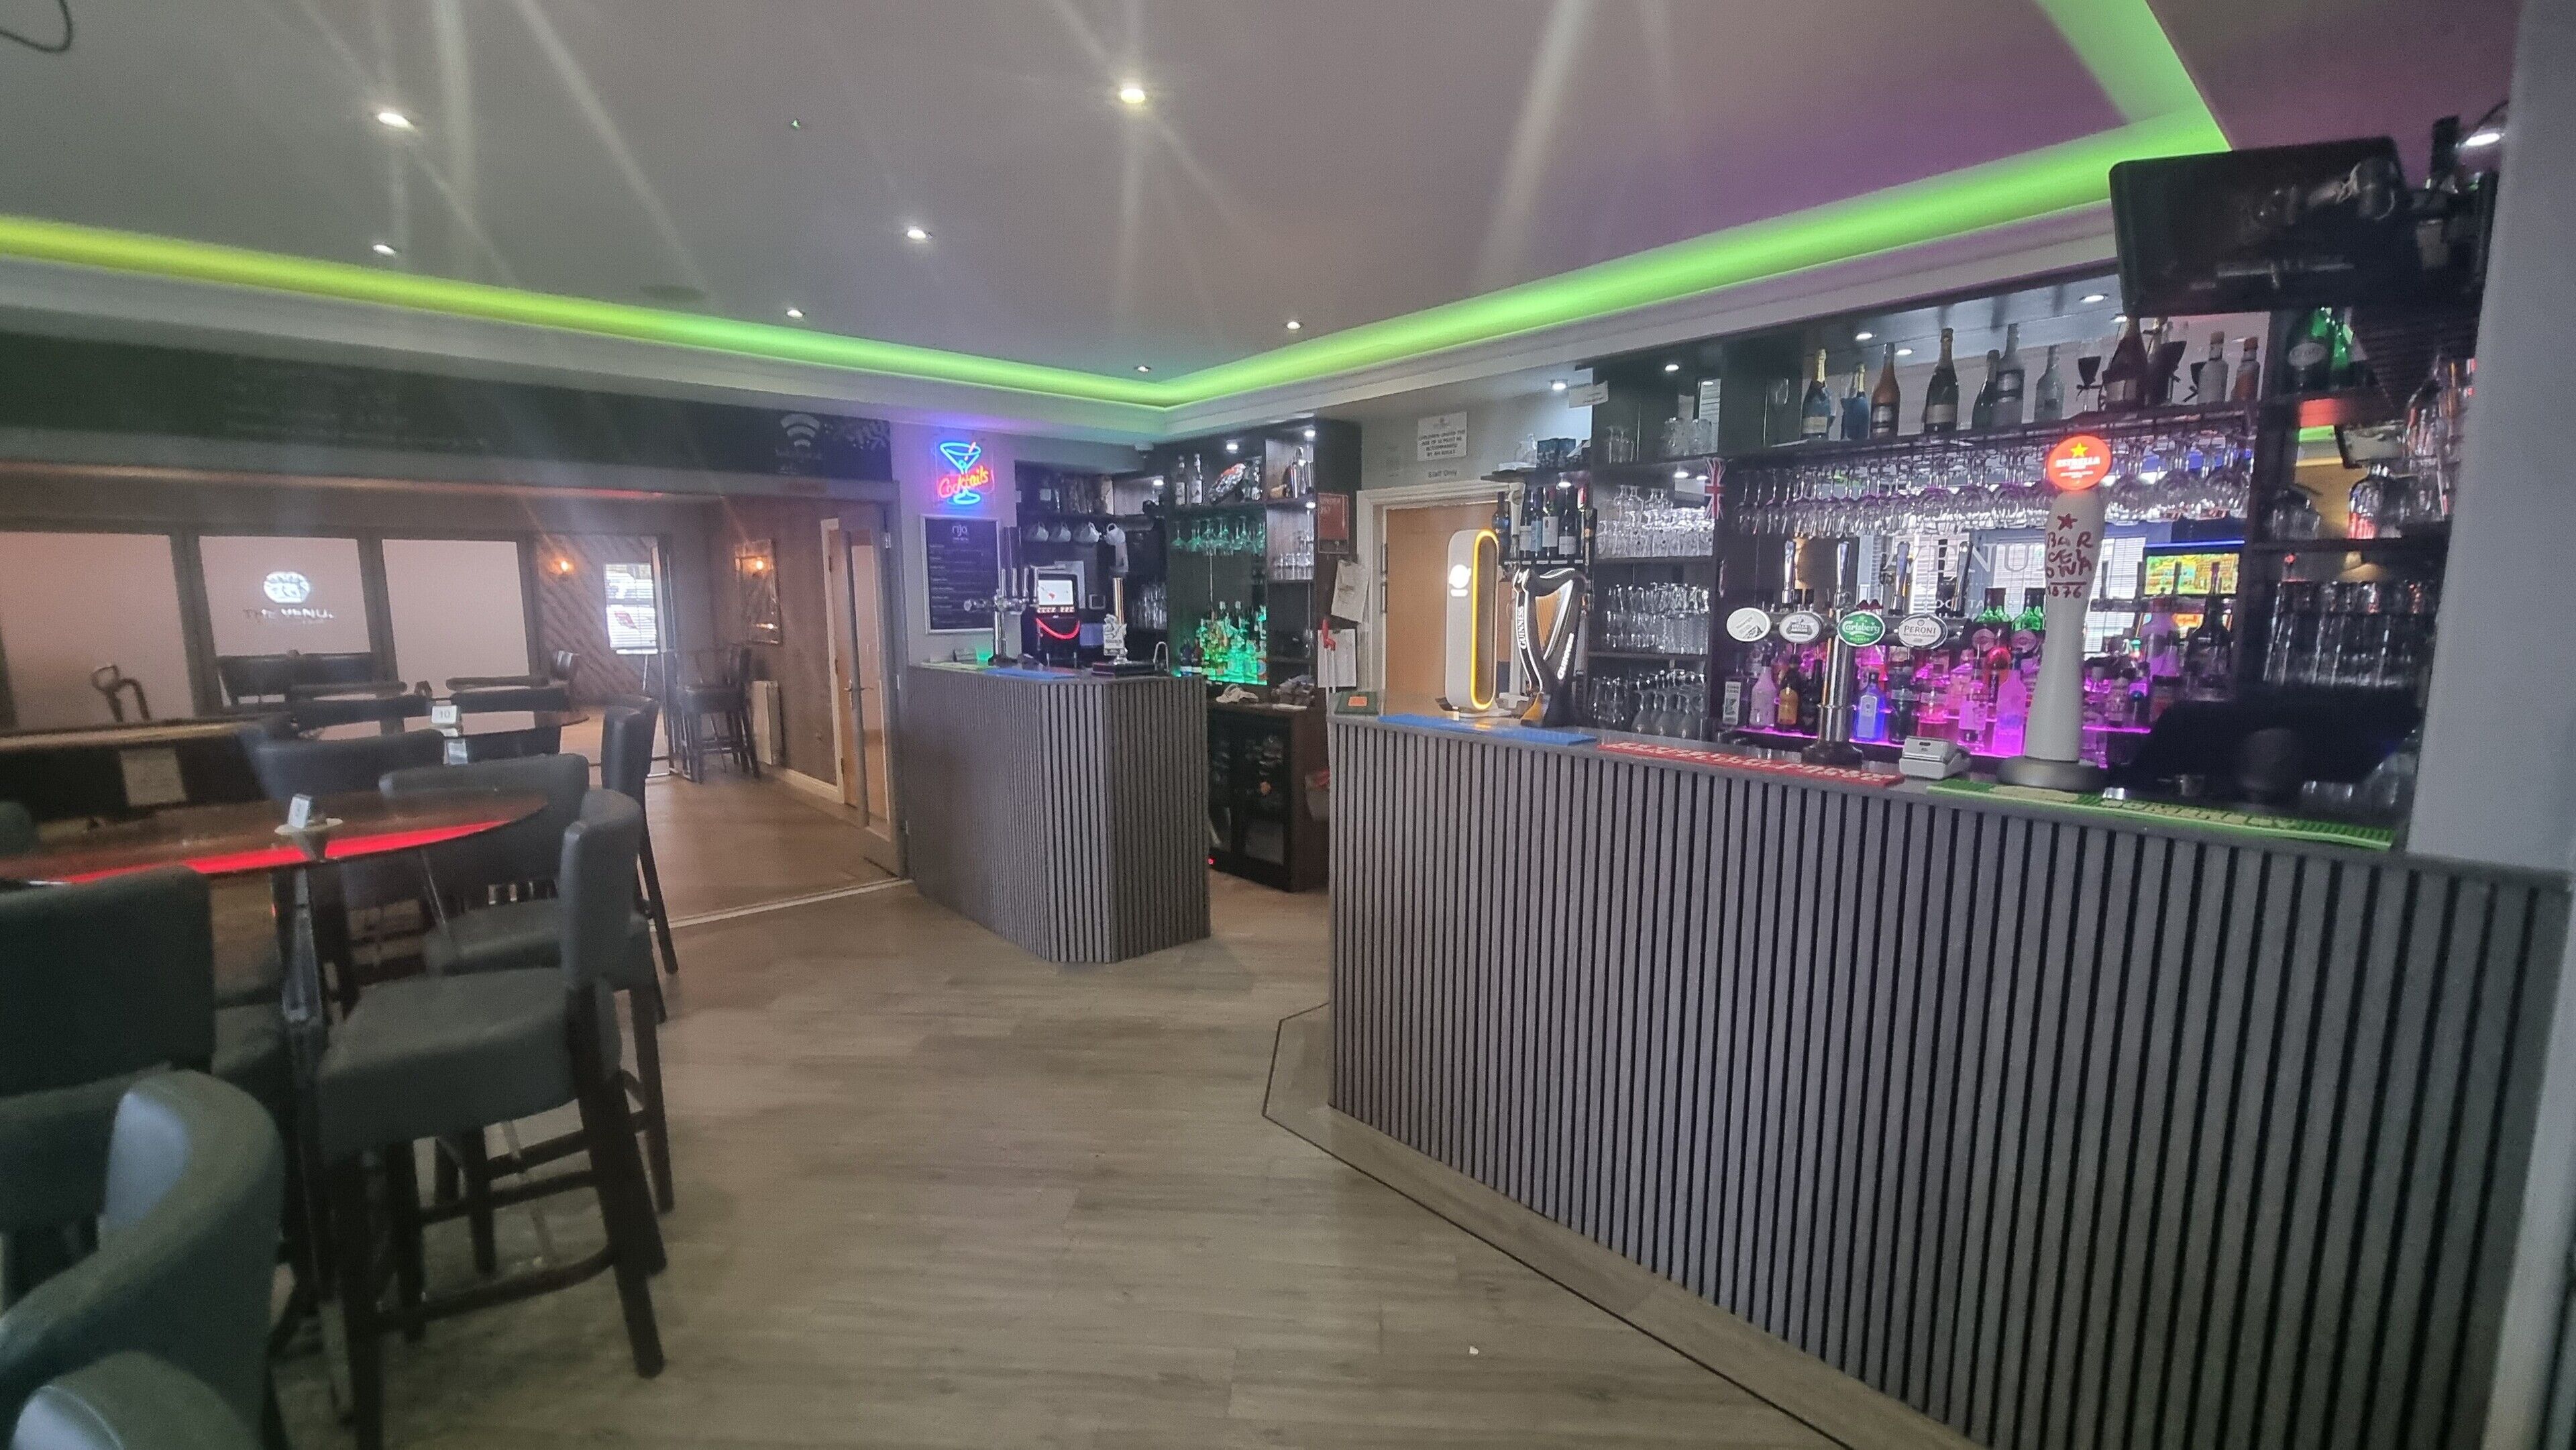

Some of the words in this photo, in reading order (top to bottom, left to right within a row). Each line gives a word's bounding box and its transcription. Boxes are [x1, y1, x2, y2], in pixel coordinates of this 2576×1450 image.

[938, 465, 989, 499] Cocktails
[1517, 605, 1527, 650] GUINNESS
[1842, 620, 1880, 635] Carlsberg
[1904, 625, 1937, 634] PERONI
[440, 709, 451, 719] 10
